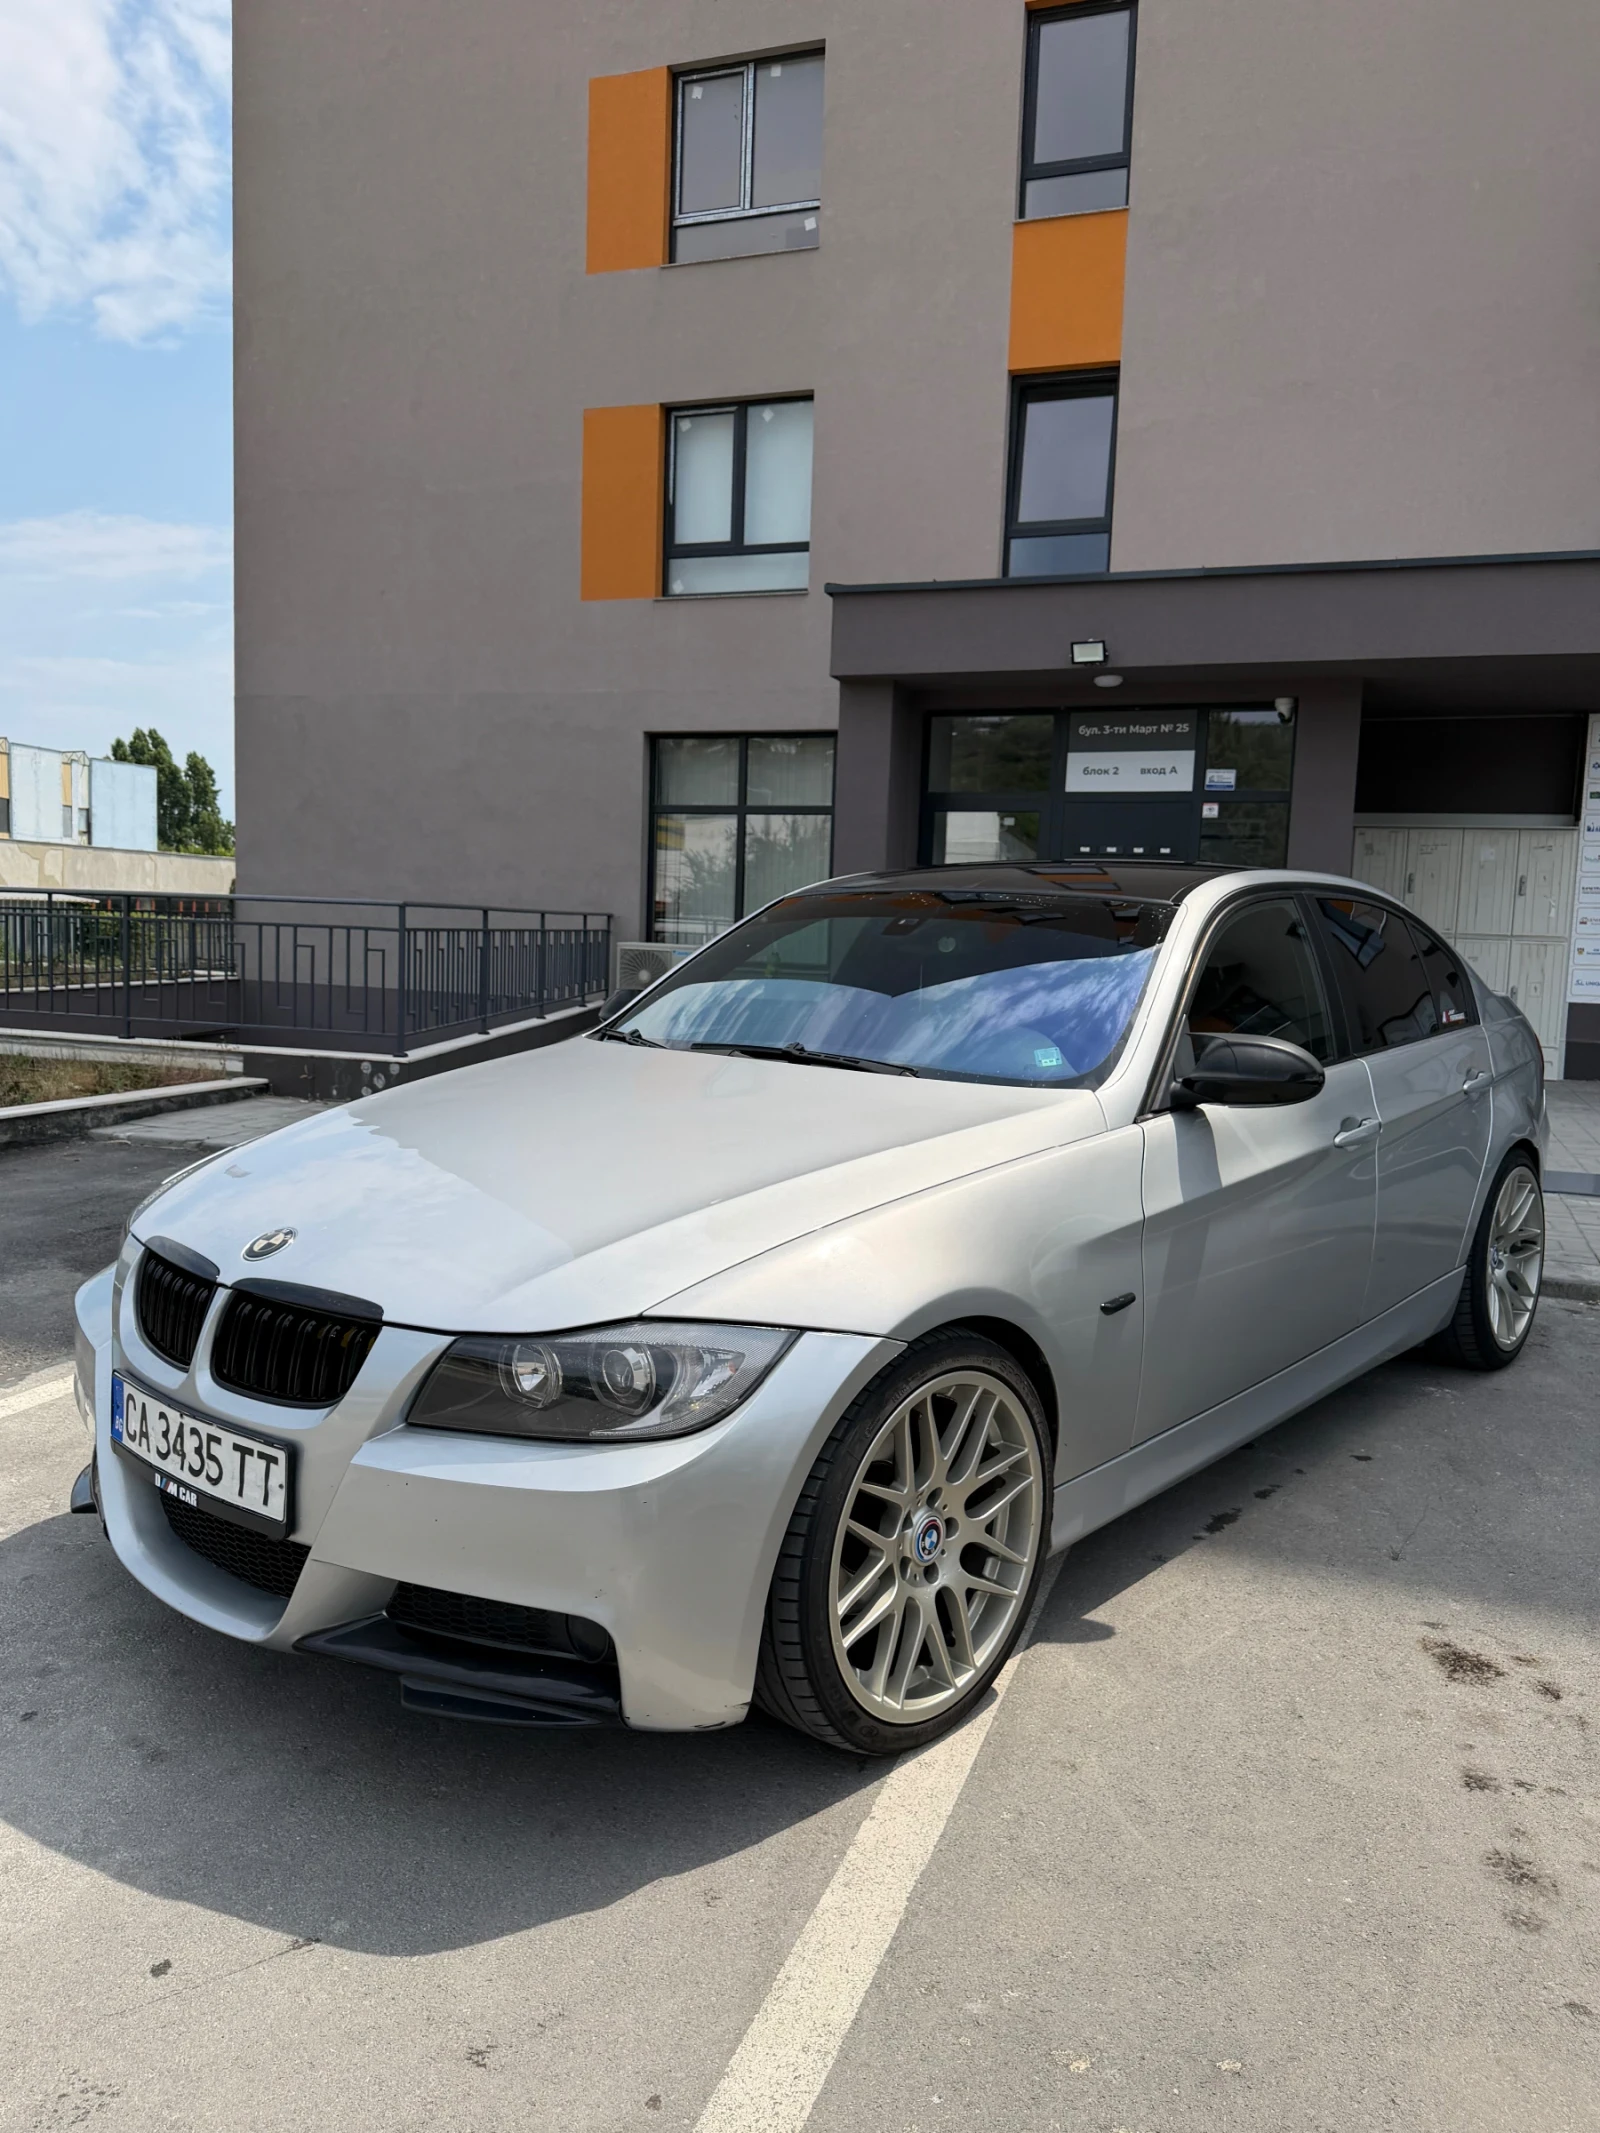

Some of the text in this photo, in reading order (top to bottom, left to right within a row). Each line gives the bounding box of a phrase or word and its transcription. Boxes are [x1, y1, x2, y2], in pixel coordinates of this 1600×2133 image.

[1078, 724, 1101, 737] бул.
[1103, 724, 1127, 735] 3-ти
[1129, 724, 1158, 736] Март
[1176, 722, 1190, 733] 25
[1082, 765, 1120, 776] блок 2
[1140, 765, 1178, 777] вход А
[115, 1414, 123, 1433] BG
[125, 1392, 279, 1507] CA 3435 TT
[179, 1486, 198, 1508] CAR
